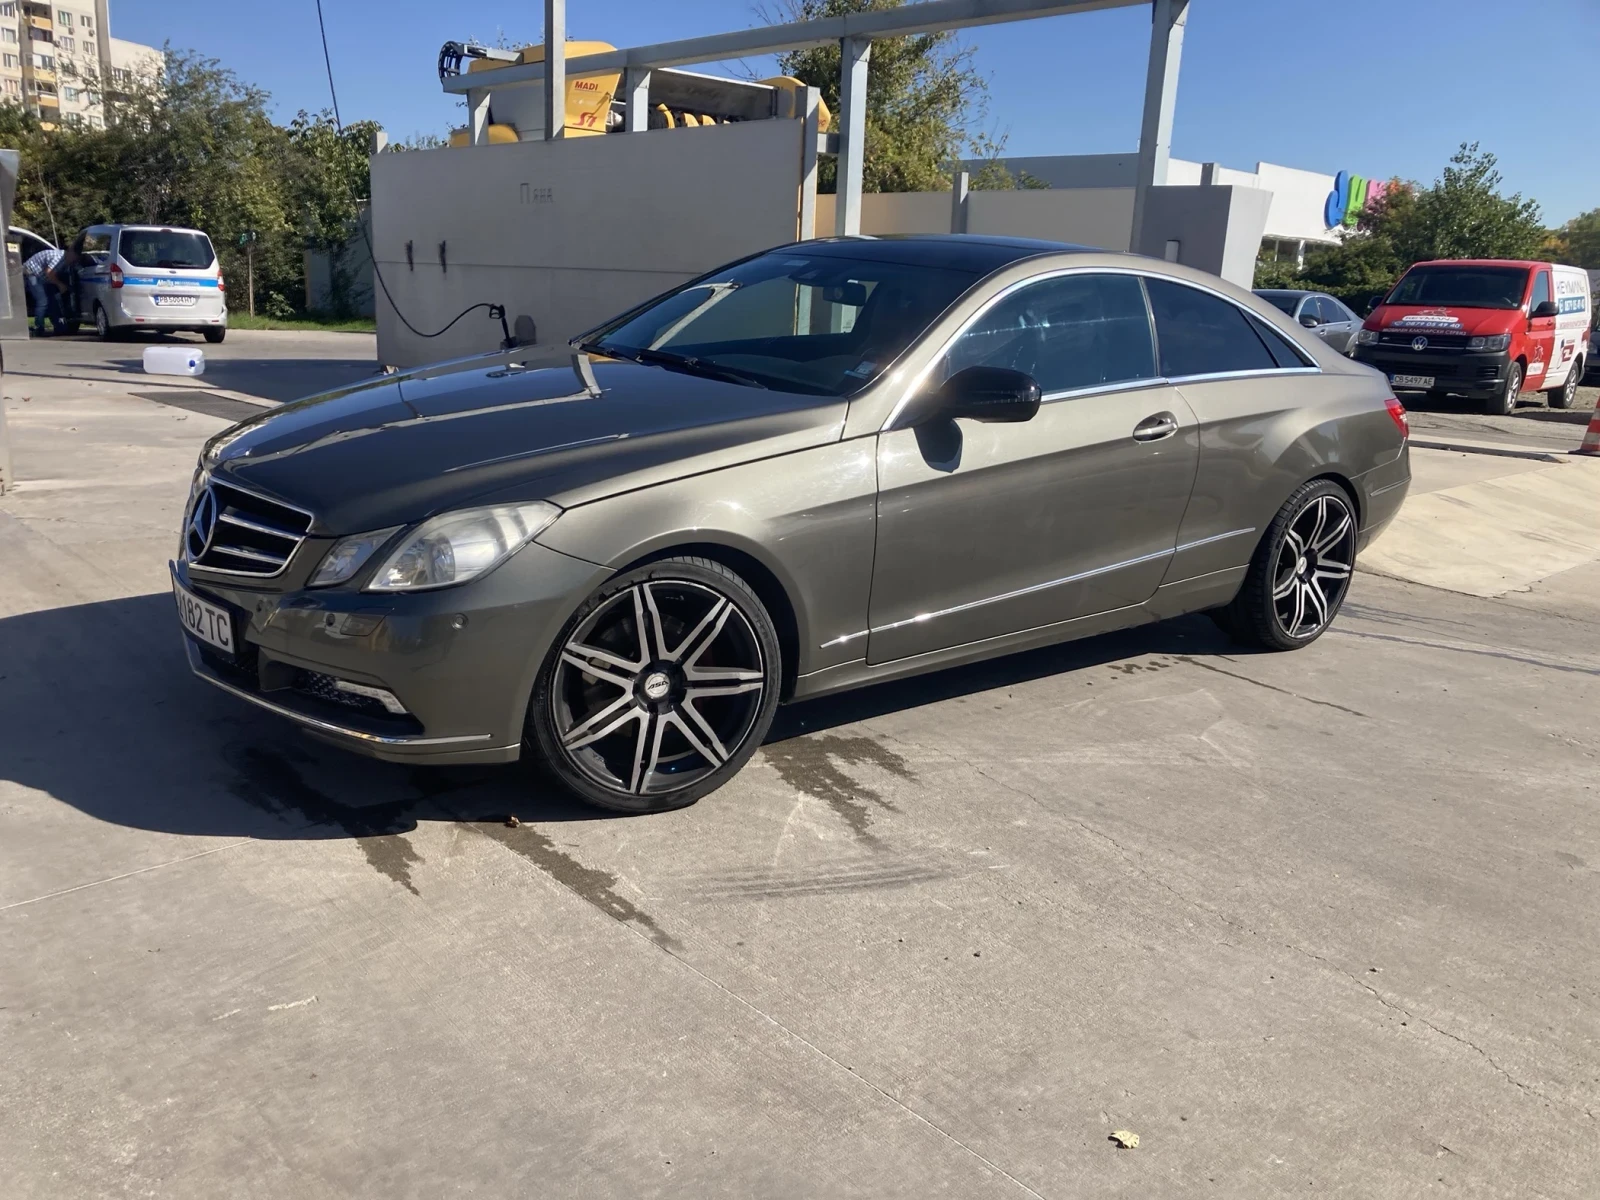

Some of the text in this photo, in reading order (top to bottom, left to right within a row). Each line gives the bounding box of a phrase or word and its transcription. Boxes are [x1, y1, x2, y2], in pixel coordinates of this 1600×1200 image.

[574, 81, 599, 91] MADI
[1394, 375, 1433, 386] CB 5497 AE
[205, 607, 229, 647] TC
